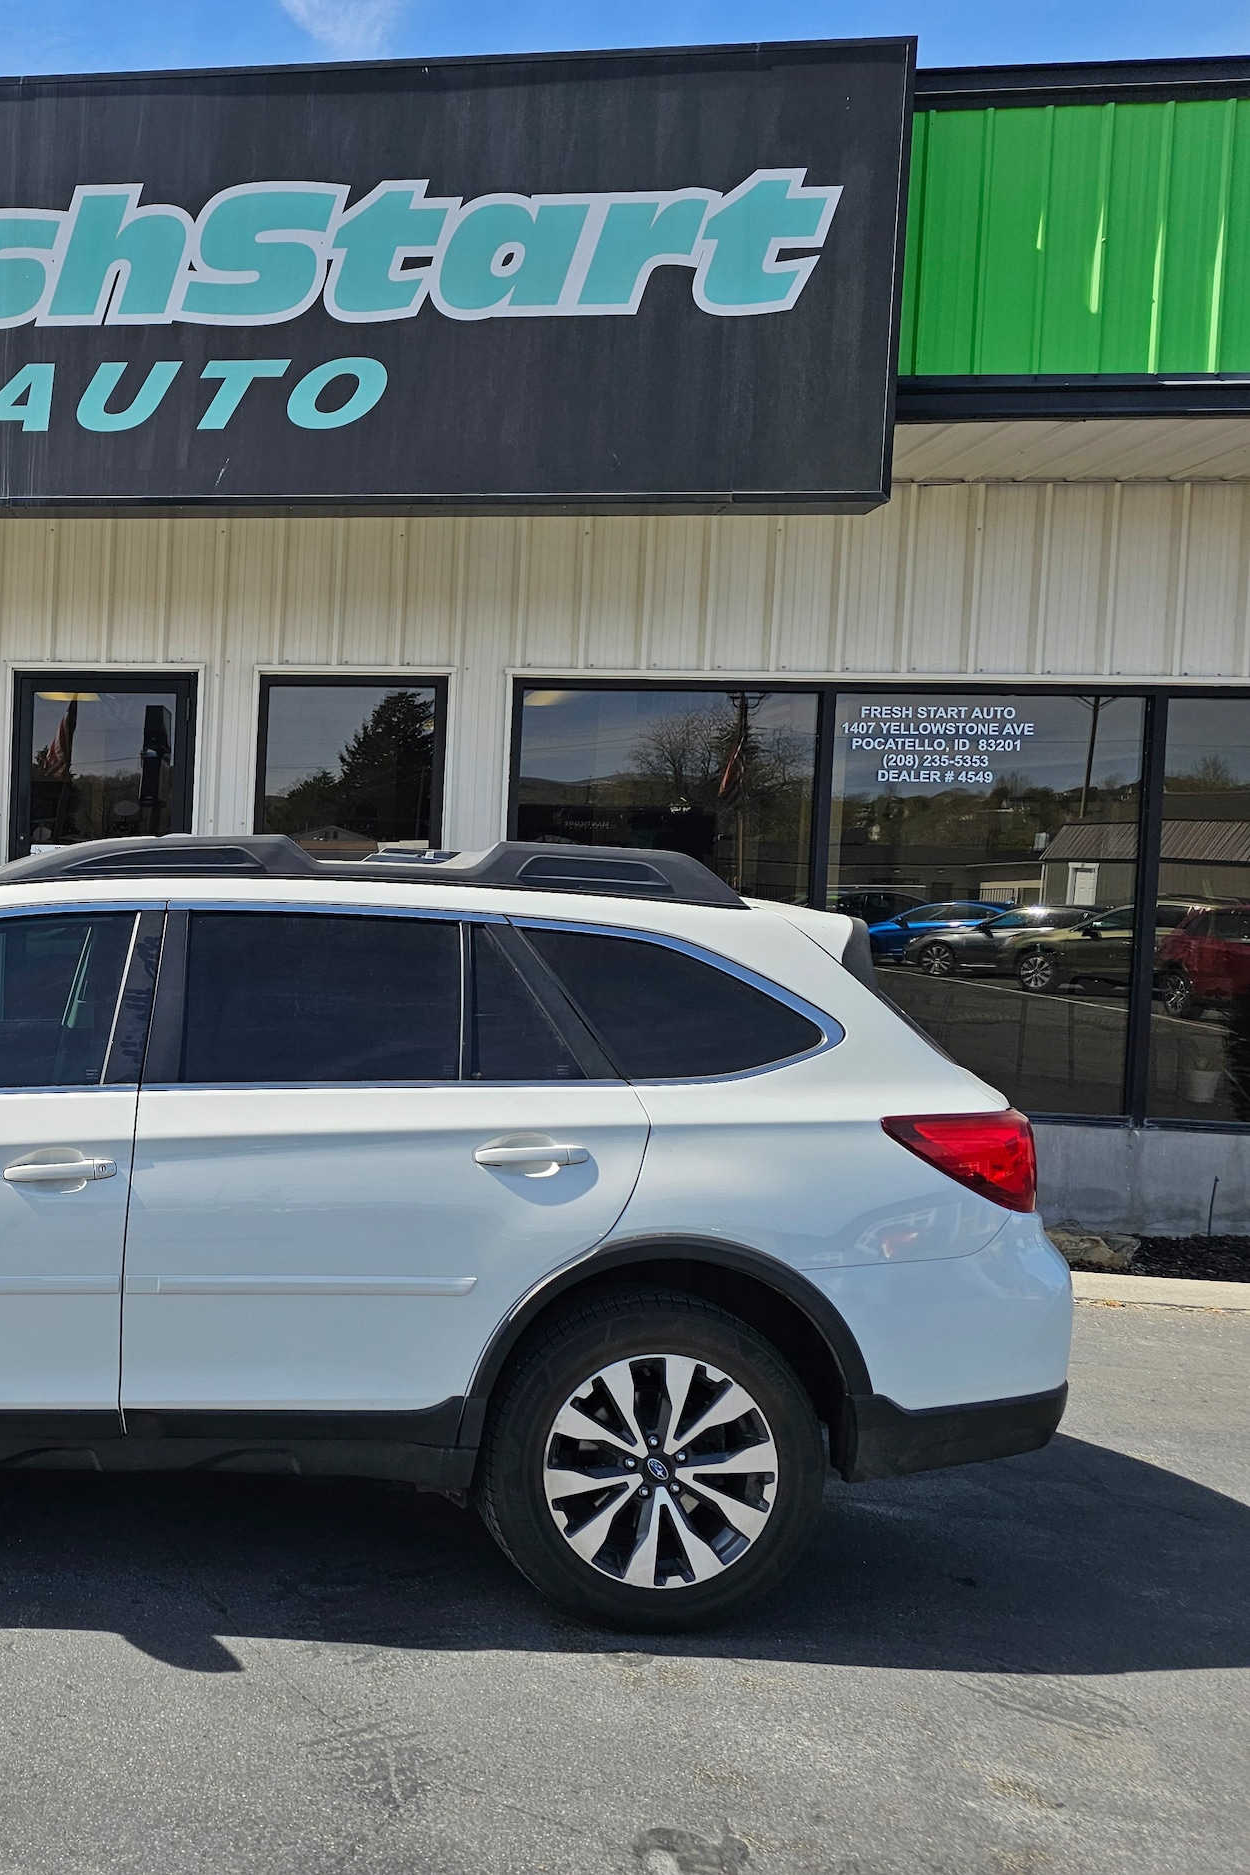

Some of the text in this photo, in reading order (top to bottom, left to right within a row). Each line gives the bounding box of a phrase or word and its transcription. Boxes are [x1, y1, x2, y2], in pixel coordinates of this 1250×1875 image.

[861, 706, 1016, 719] FRESH START AUTO
[842, 722, 1035, 736] 1407 YELLOWSTONE AVE
[852, 738, 1021, 753] POCATELLO, ID 83201
[882, 754, 989, 769] (208) 235-5353
[877, 770, 993, 784] DEALER # 4549
